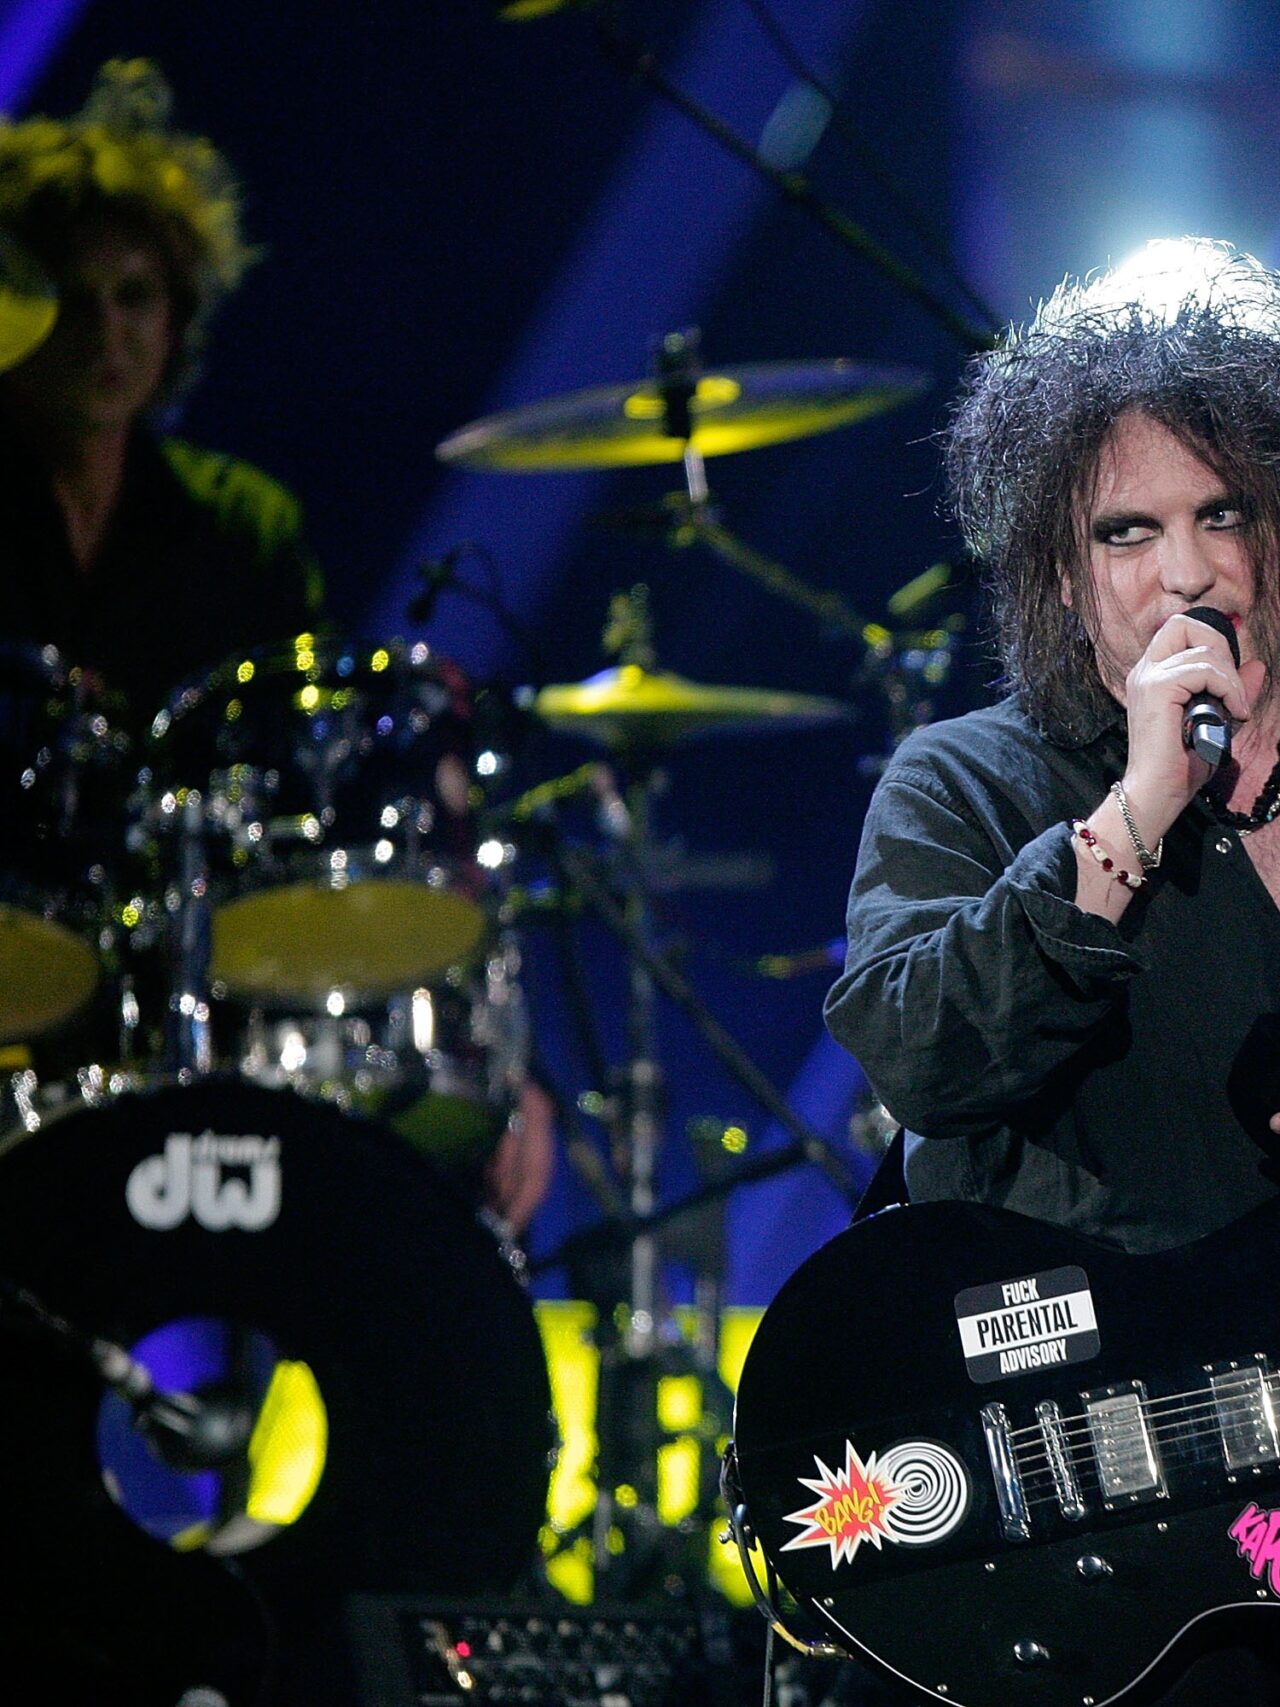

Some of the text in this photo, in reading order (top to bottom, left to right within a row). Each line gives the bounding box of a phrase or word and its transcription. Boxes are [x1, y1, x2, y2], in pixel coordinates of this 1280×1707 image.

[1001, 1278, 1040, 1306] FUCK
[976, 1300, 1079, 1349] PARENTAL
[999, 1338, 1068, 1375] ADVISORY
[814, 1482, 885, 1536] BANG!
